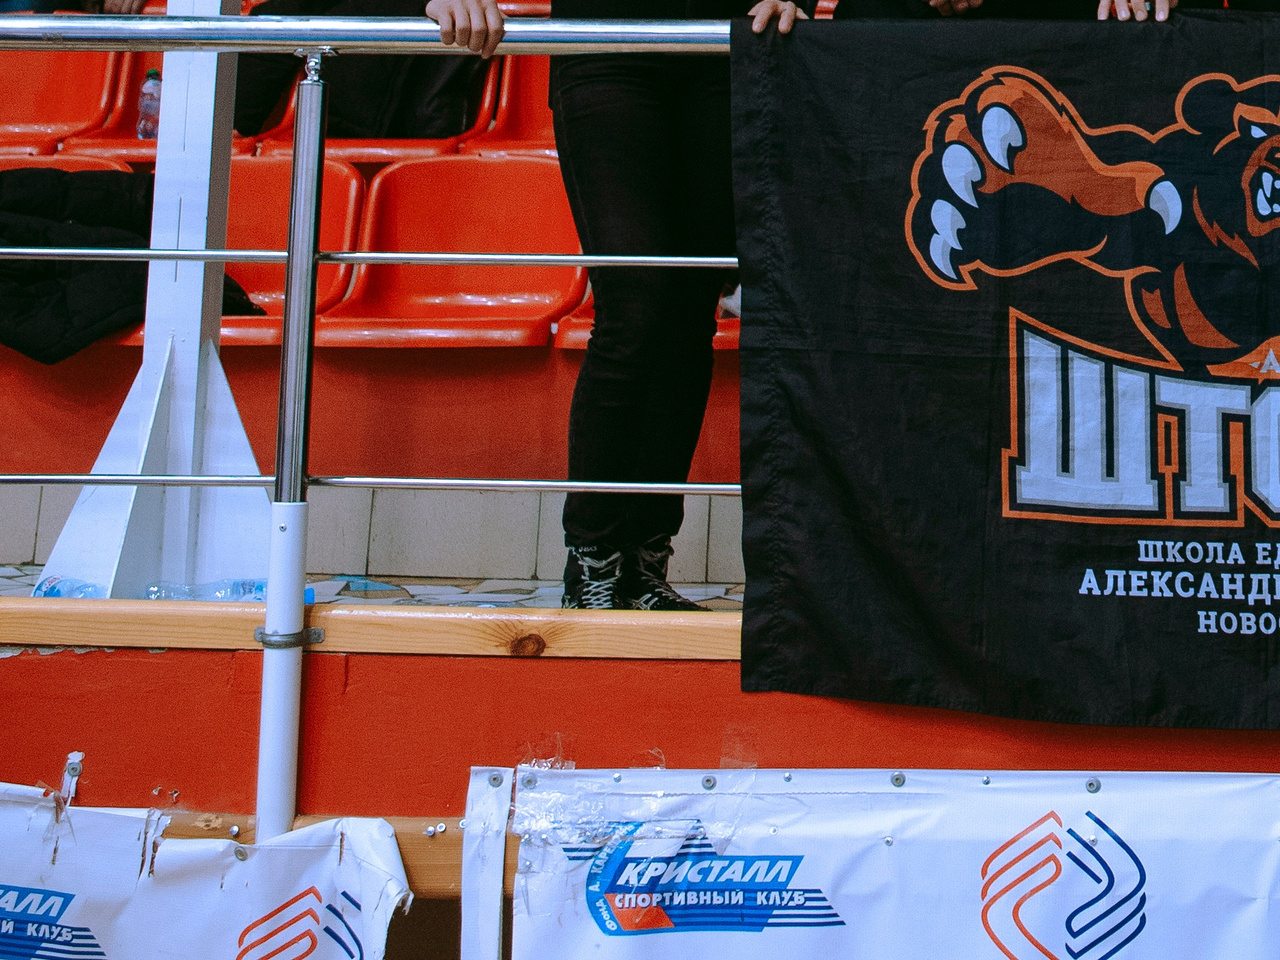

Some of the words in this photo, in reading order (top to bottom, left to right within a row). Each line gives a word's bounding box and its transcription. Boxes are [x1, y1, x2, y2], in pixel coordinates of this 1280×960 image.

[1137, 539, 1245, 565] ШКОЛА
[616, 860, 793, 886] КРИСТАЛЛ
[614, 889, 743, 908] СПОРТИВНЫЙ
[756, 890, 806, 906] КЛУБ
[27, 922, 73, 942] КЛУБ
